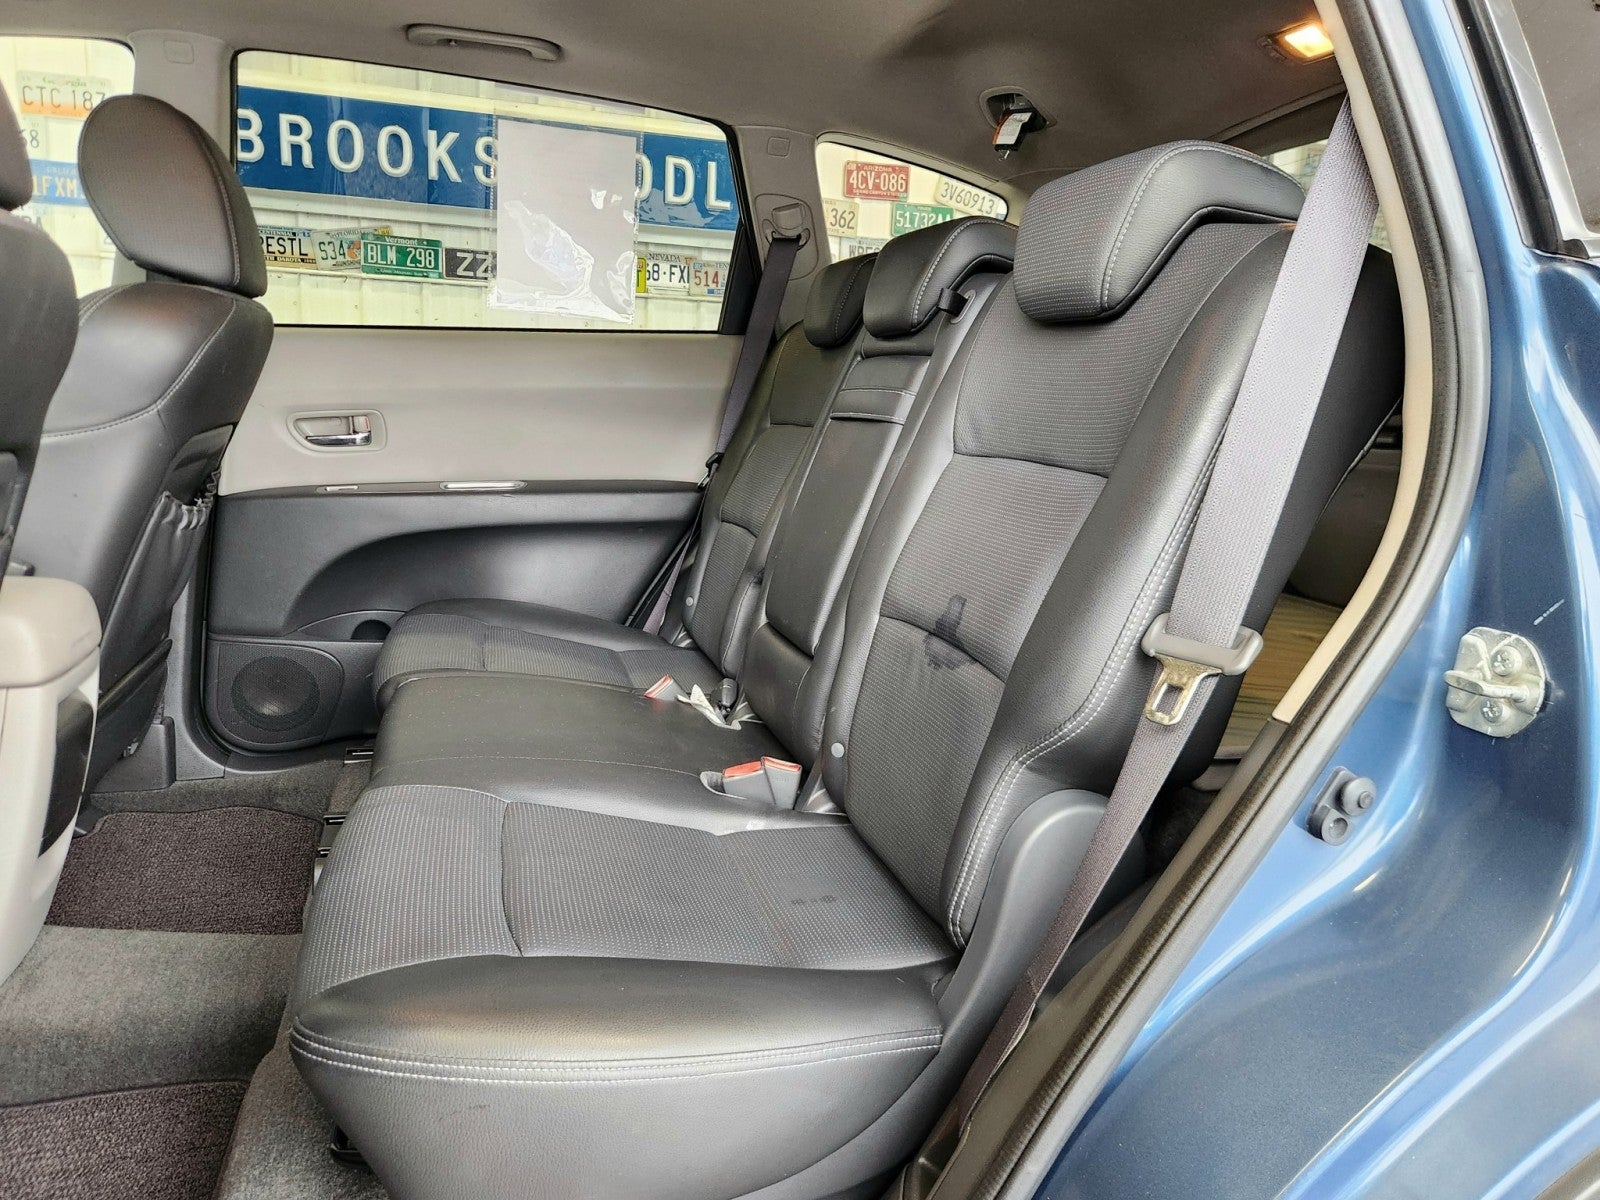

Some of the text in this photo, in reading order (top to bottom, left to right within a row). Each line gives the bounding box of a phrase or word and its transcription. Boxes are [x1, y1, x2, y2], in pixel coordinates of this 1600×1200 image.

[22, 85, 61, 109] CTC
[237, 108, 498, 188] BROOKS
[863, 165, 893, 173] ARIZONA
[849, 170, 907, 193] 4CV-086
[940, 181, 995, 215] 3V60913
[829, 207, 856, 231] 362
[384, 236, 418, 247] Vermont
[367, 243, 435, 269] BLM 298
[648, 252, 682, 263] NEVADA
[694, 270, 720, 288] 514
